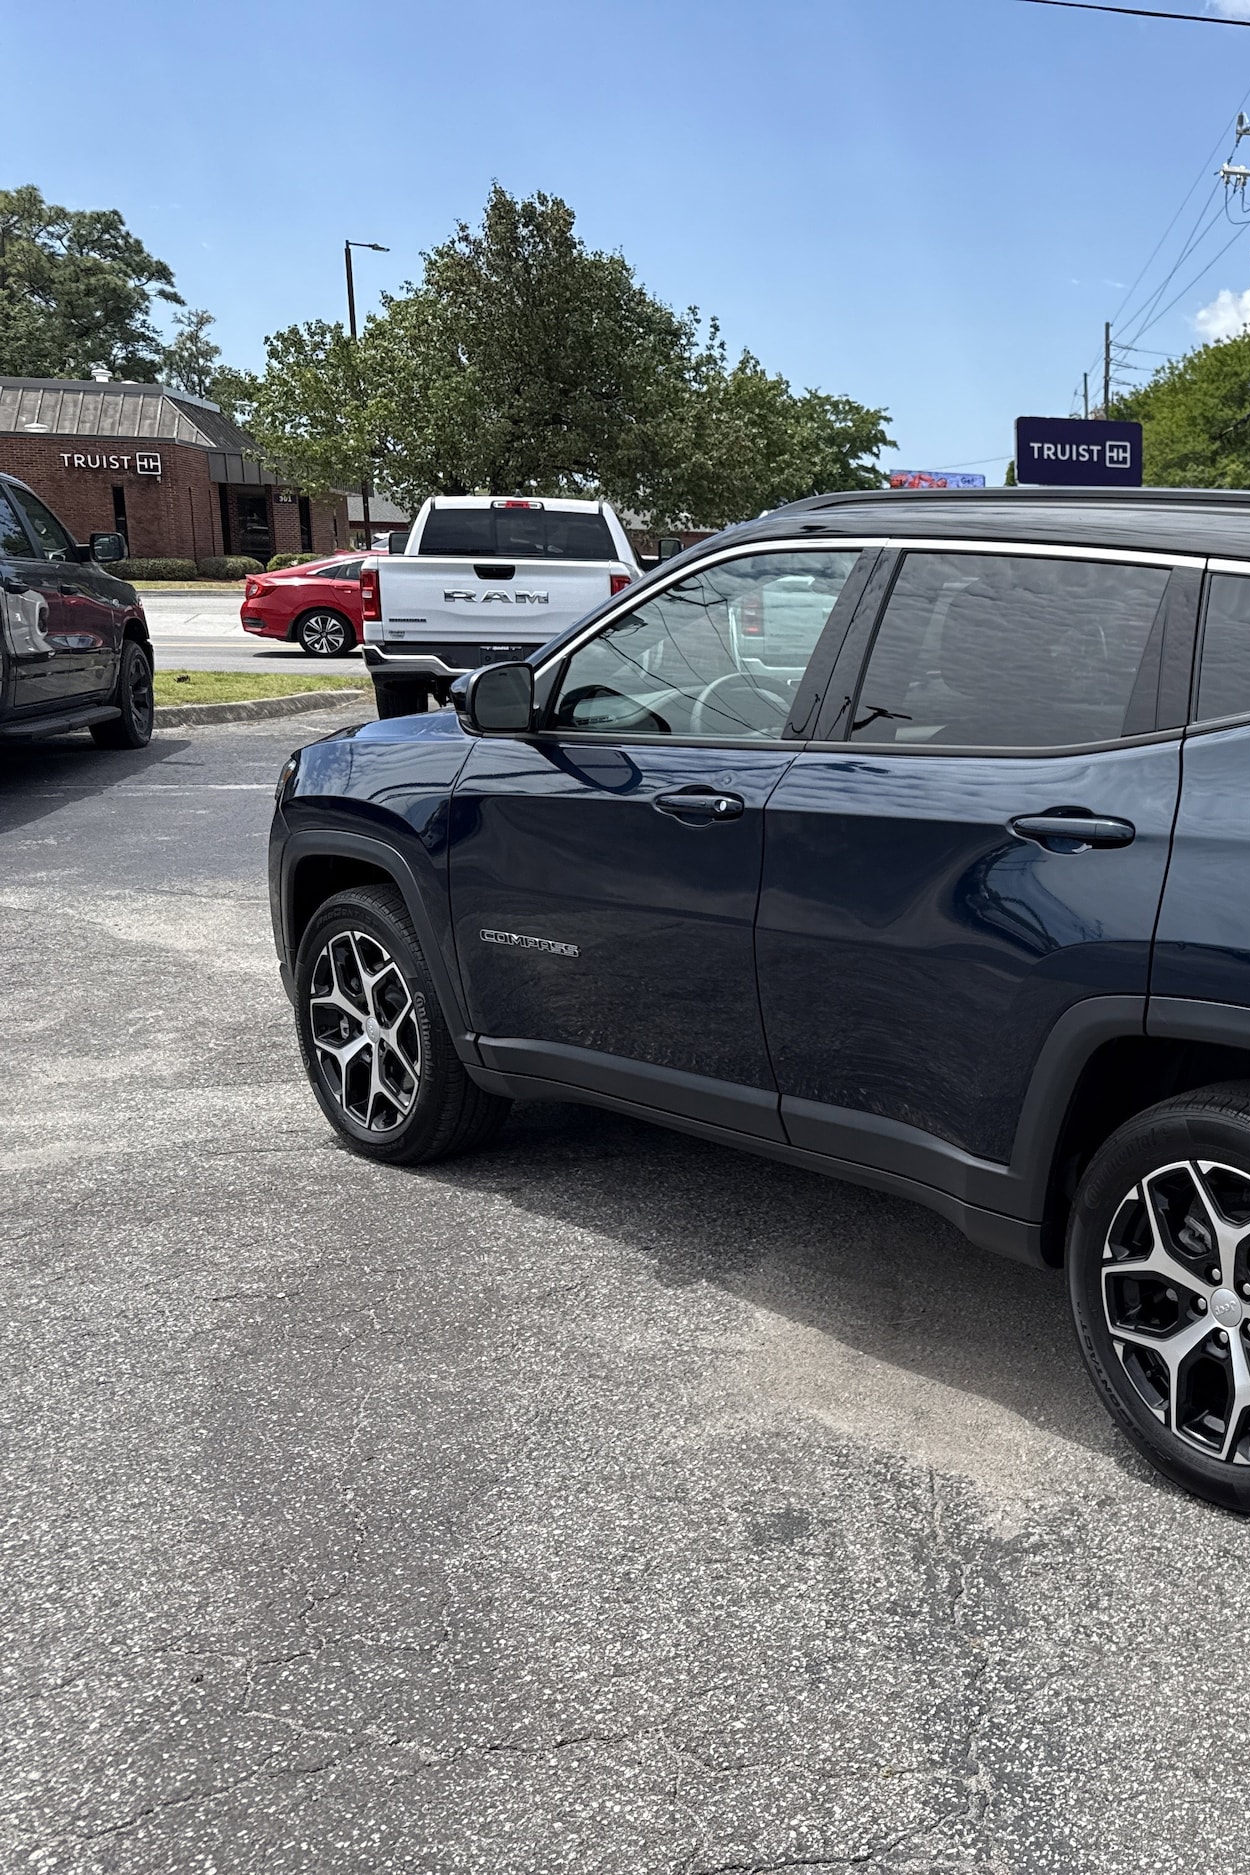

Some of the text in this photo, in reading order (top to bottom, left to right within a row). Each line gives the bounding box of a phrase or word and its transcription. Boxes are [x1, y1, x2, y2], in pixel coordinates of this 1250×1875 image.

[59, 453, 132, 470] TRUIST
[1029, 442, 1102, 463] TRUIST
[443, 588, 549, 604] RAM
[479, 928, 582, 958] COMPASS
